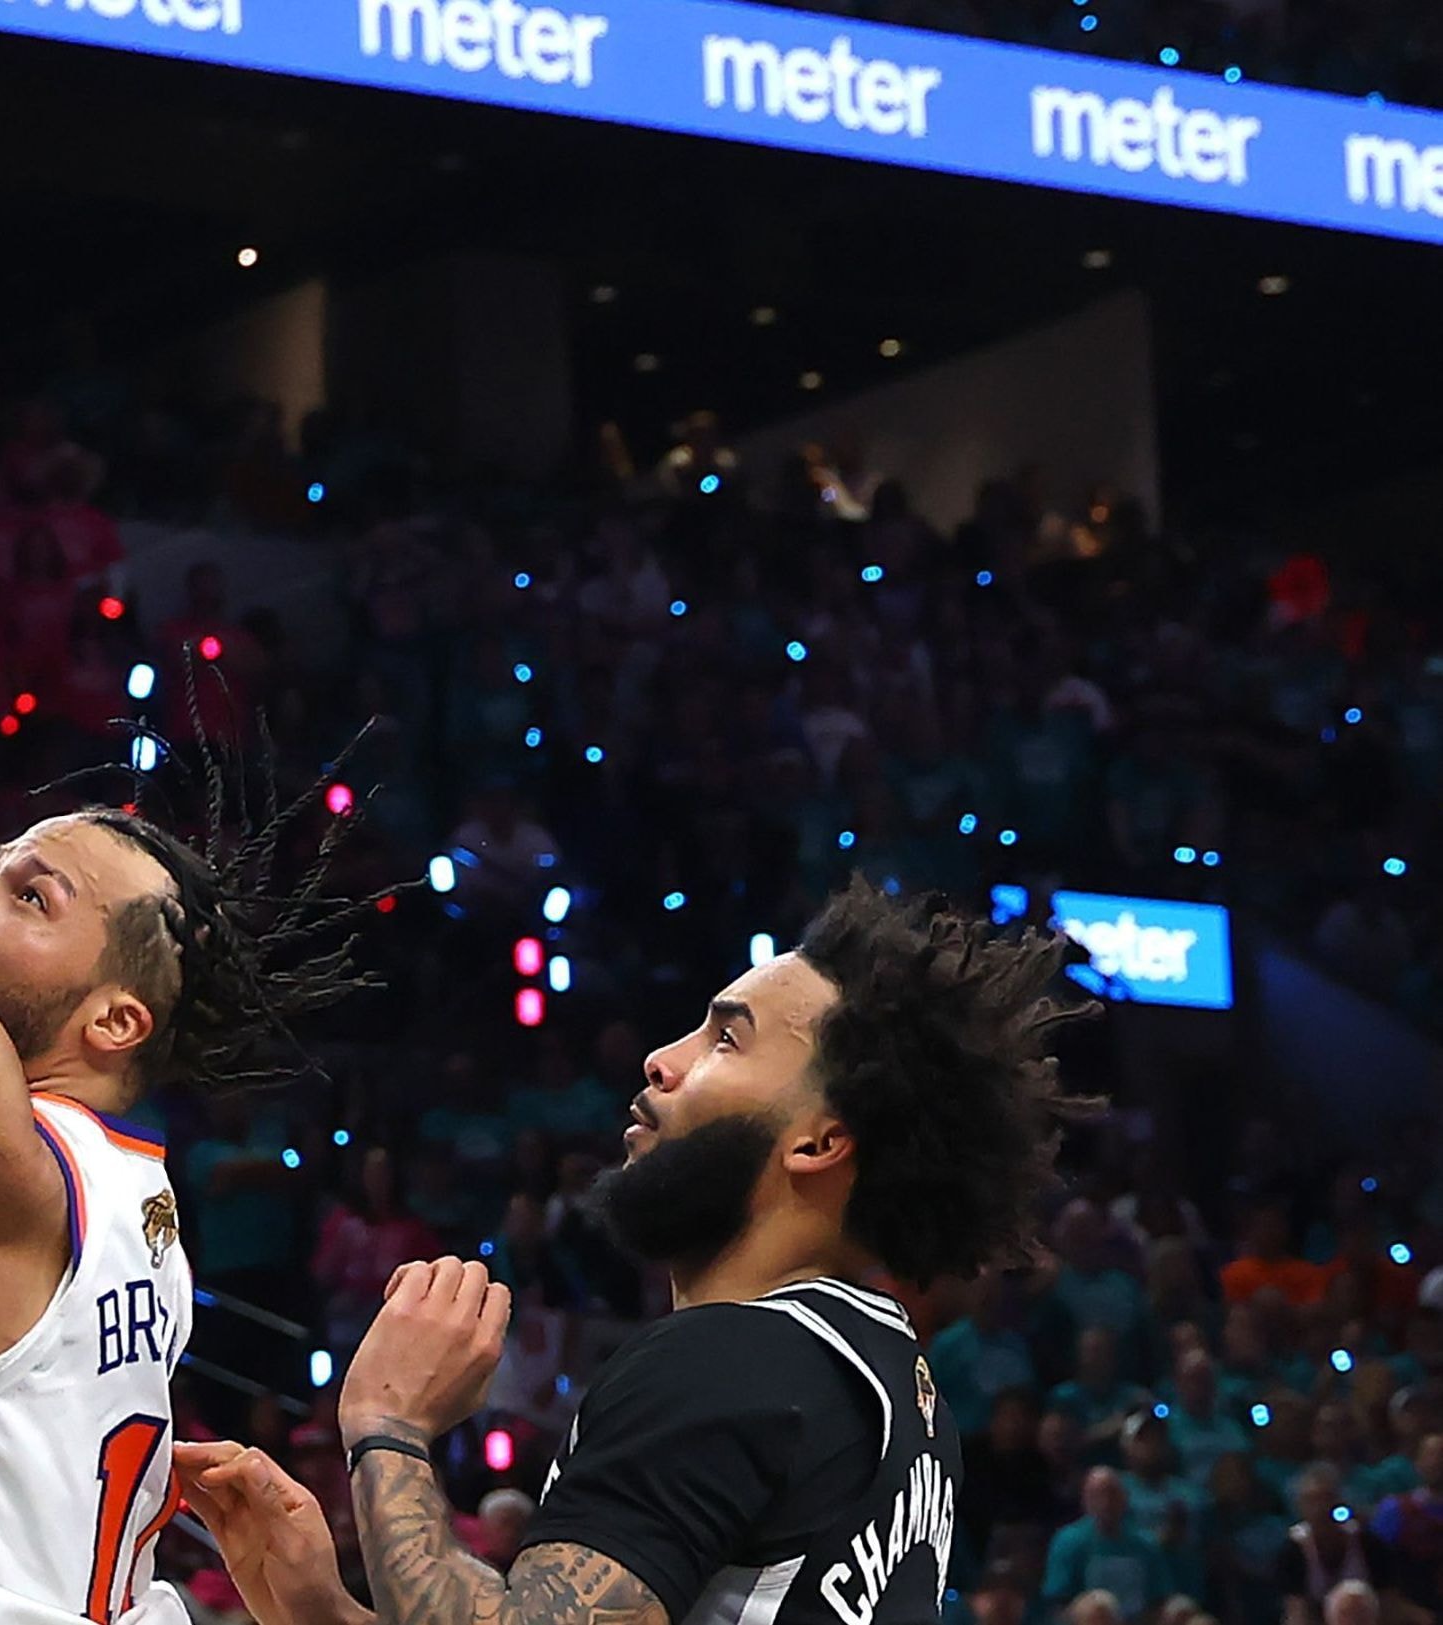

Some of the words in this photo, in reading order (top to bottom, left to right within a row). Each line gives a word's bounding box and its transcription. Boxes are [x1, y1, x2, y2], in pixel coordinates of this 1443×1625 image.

[359, 0, 607, 88] meter
[702, 35, 941, 137] meter
[1031, 85, 1261, 186] meter
[1062, 911, 1198, 981] eter
[97, 1279, 177, 1377] BR
